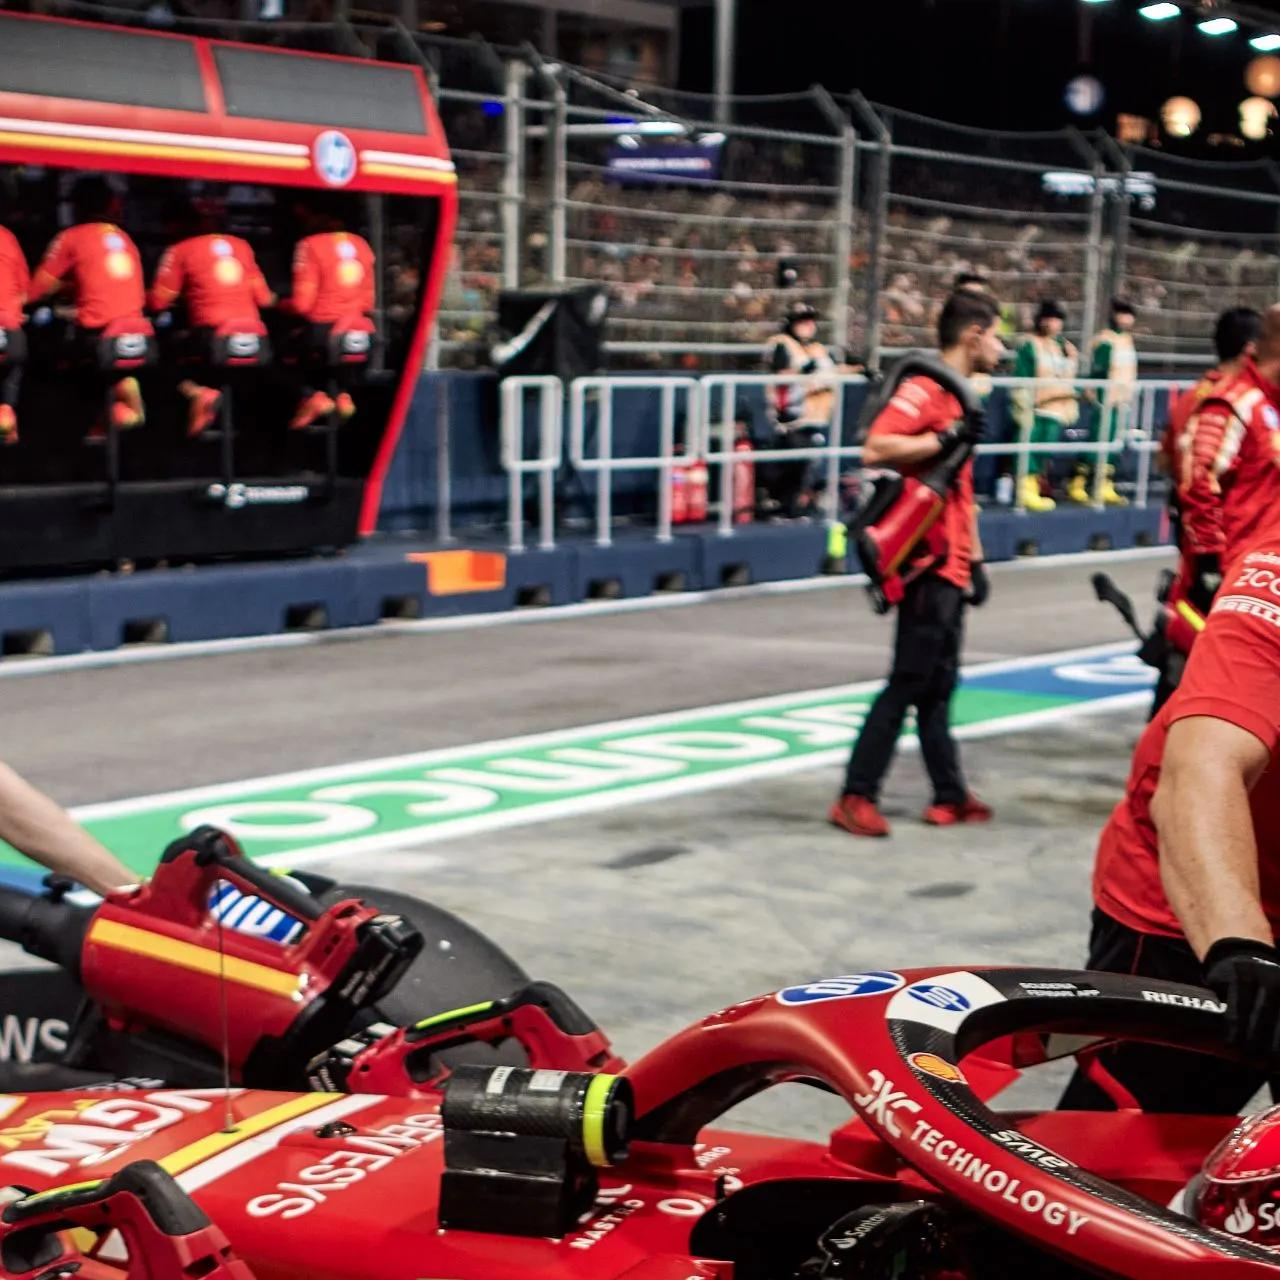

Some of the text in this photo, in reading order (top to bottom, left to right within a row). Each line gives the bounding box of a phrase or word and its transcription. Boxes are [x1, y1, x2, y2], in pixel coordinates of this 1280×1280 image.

[181, 688, 918, 838] ramco
[907, 985, 970, 1012] hp
[246, 1112, 444, 1220] GENESYS
[910, 1119, 1090, 1236] TECHNOLOGY
